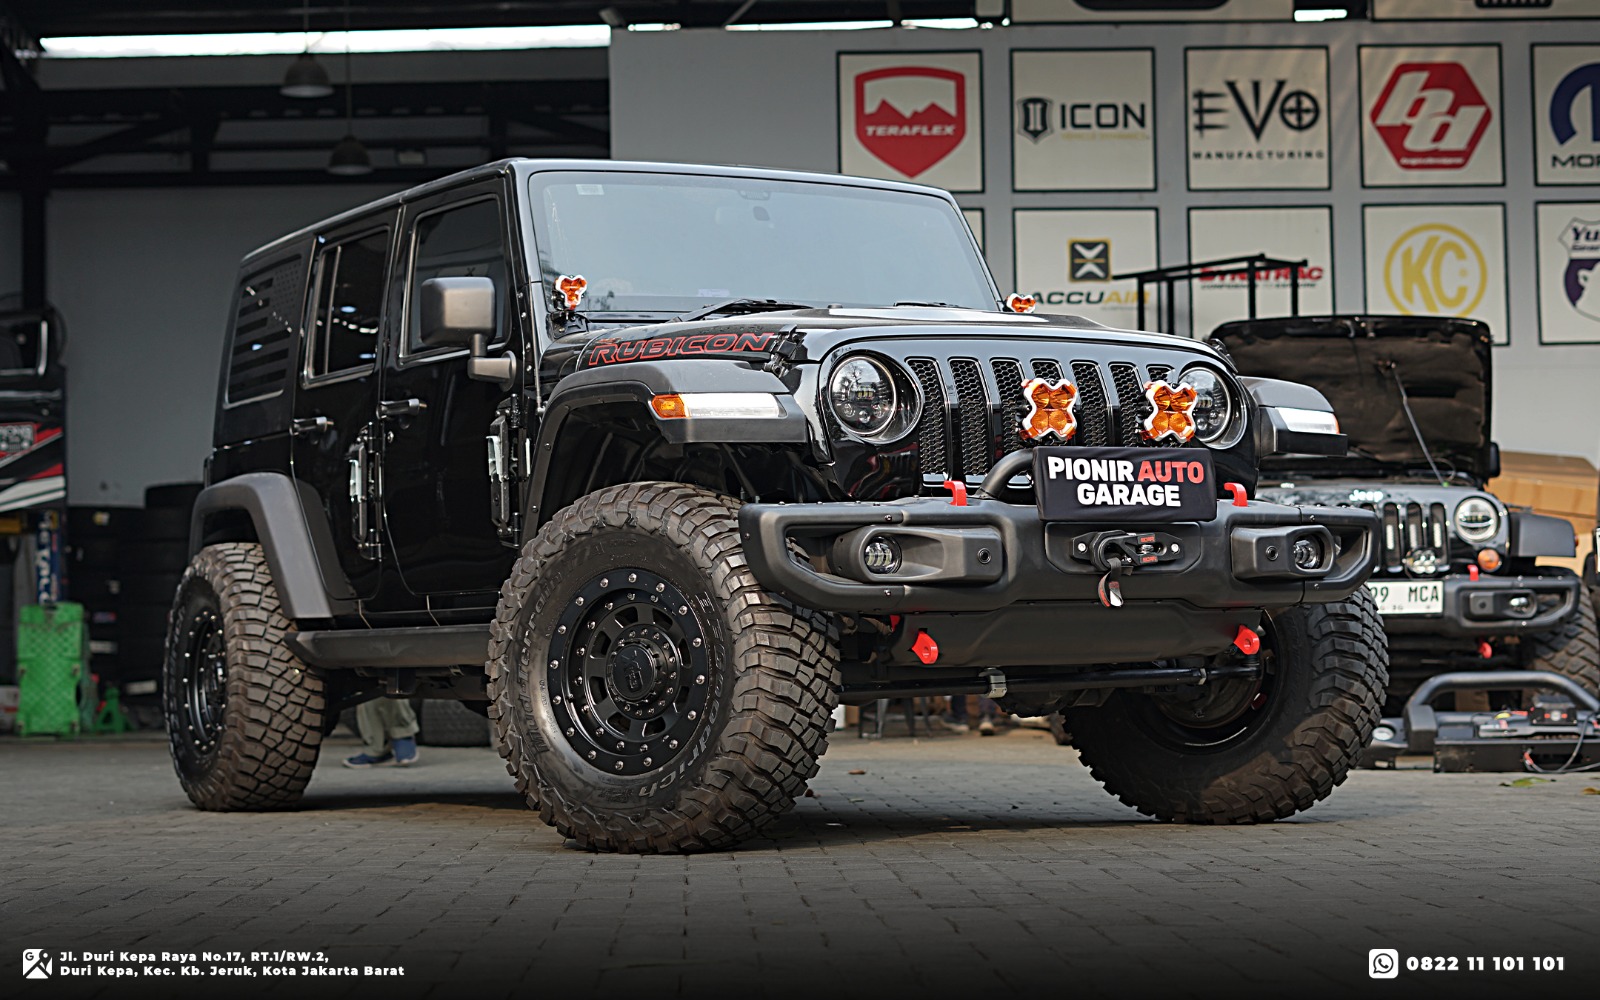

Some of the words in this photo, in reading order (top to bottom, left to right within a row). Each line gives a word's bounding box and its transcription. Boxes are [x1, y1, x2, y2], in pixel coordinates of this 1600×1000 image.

[1060, 103, 1146, 129] ICON
[1193, 80, 1320, 141] EVO
[865, 125, 956, 136] TERAFLEX
[1192, 150, 1325, 160] MANUFACTURING
[1552, 154, 1600, 168] MO
[588, 332, 775, 366] RUBICON
[1048, 456, 1134, 482] PIONIR
[1137, 460, 1204, 484] AUTO
[1077, 482, 1181, 507] GARAGE
[1349, 489, 1384, 503] Jeep
[1408, 585, 1439, 602] MCA
